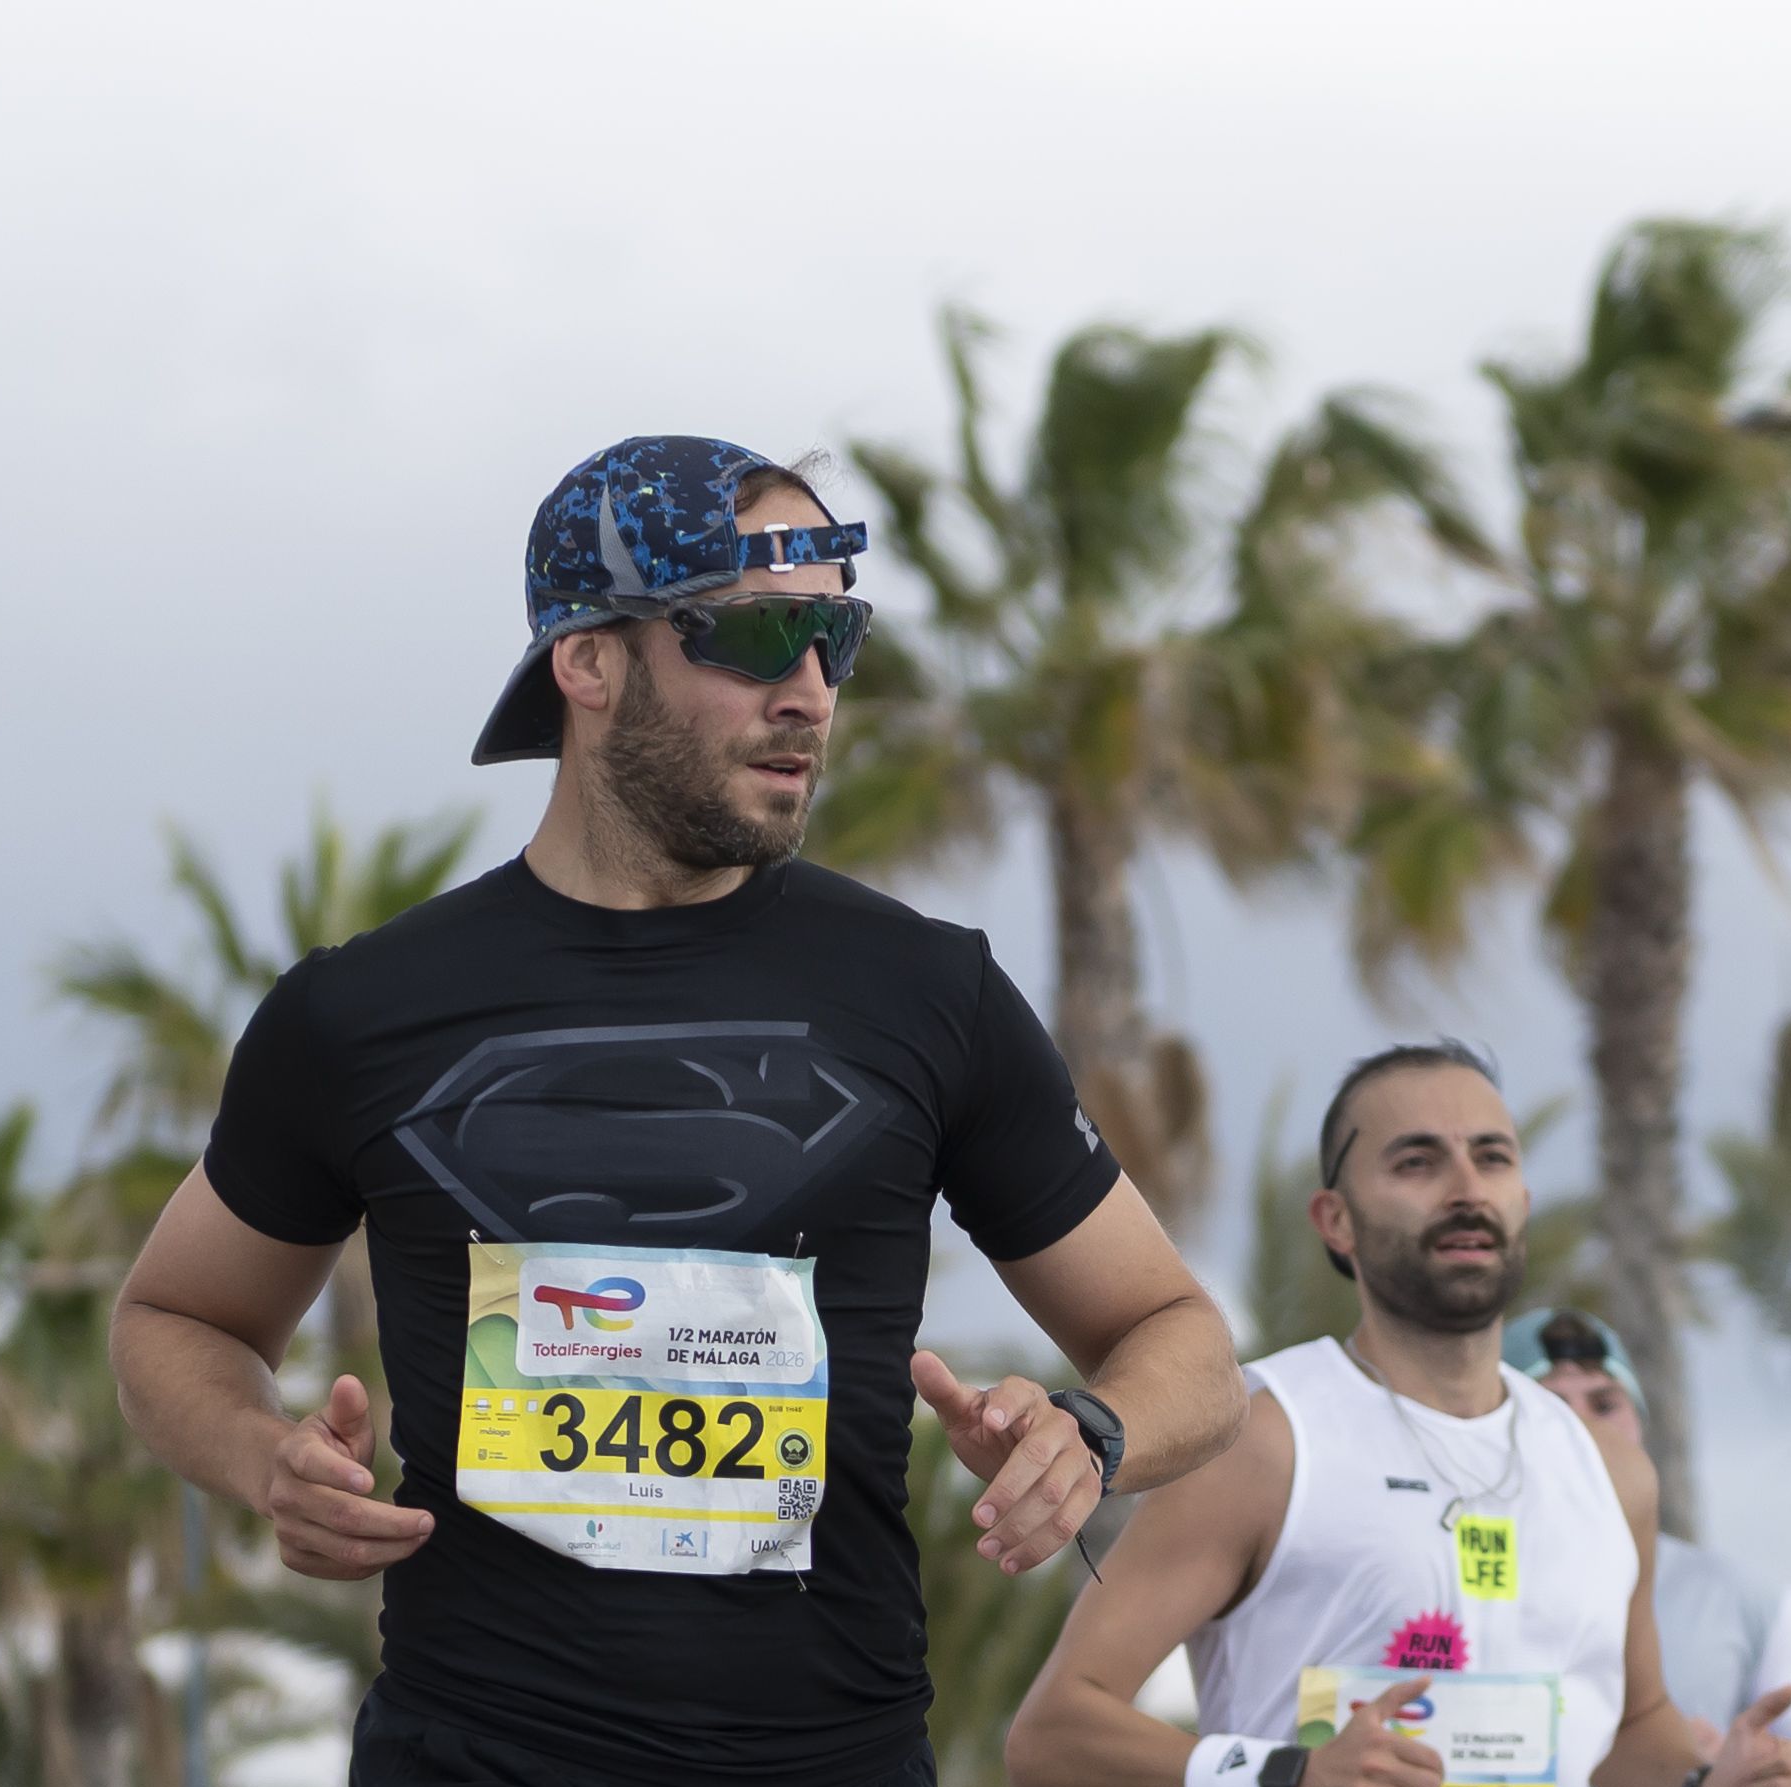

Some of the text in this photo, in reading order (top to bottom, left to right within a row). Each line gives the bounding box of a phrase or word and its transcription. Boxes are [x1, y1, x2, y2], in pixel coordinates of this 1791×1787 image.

[668, 1327, 777, 1345] 1/2 MARATÓN
[532, 1343, 642, 1360] TotalEnergies
[667, 1348, 805, 1367] DE MÁLAGA 2026
[540, 1393, 764, 1479] 3482
[629, 1482, 663, 1499] Luís
[1409, 1632, 1453, 1655] RUN
